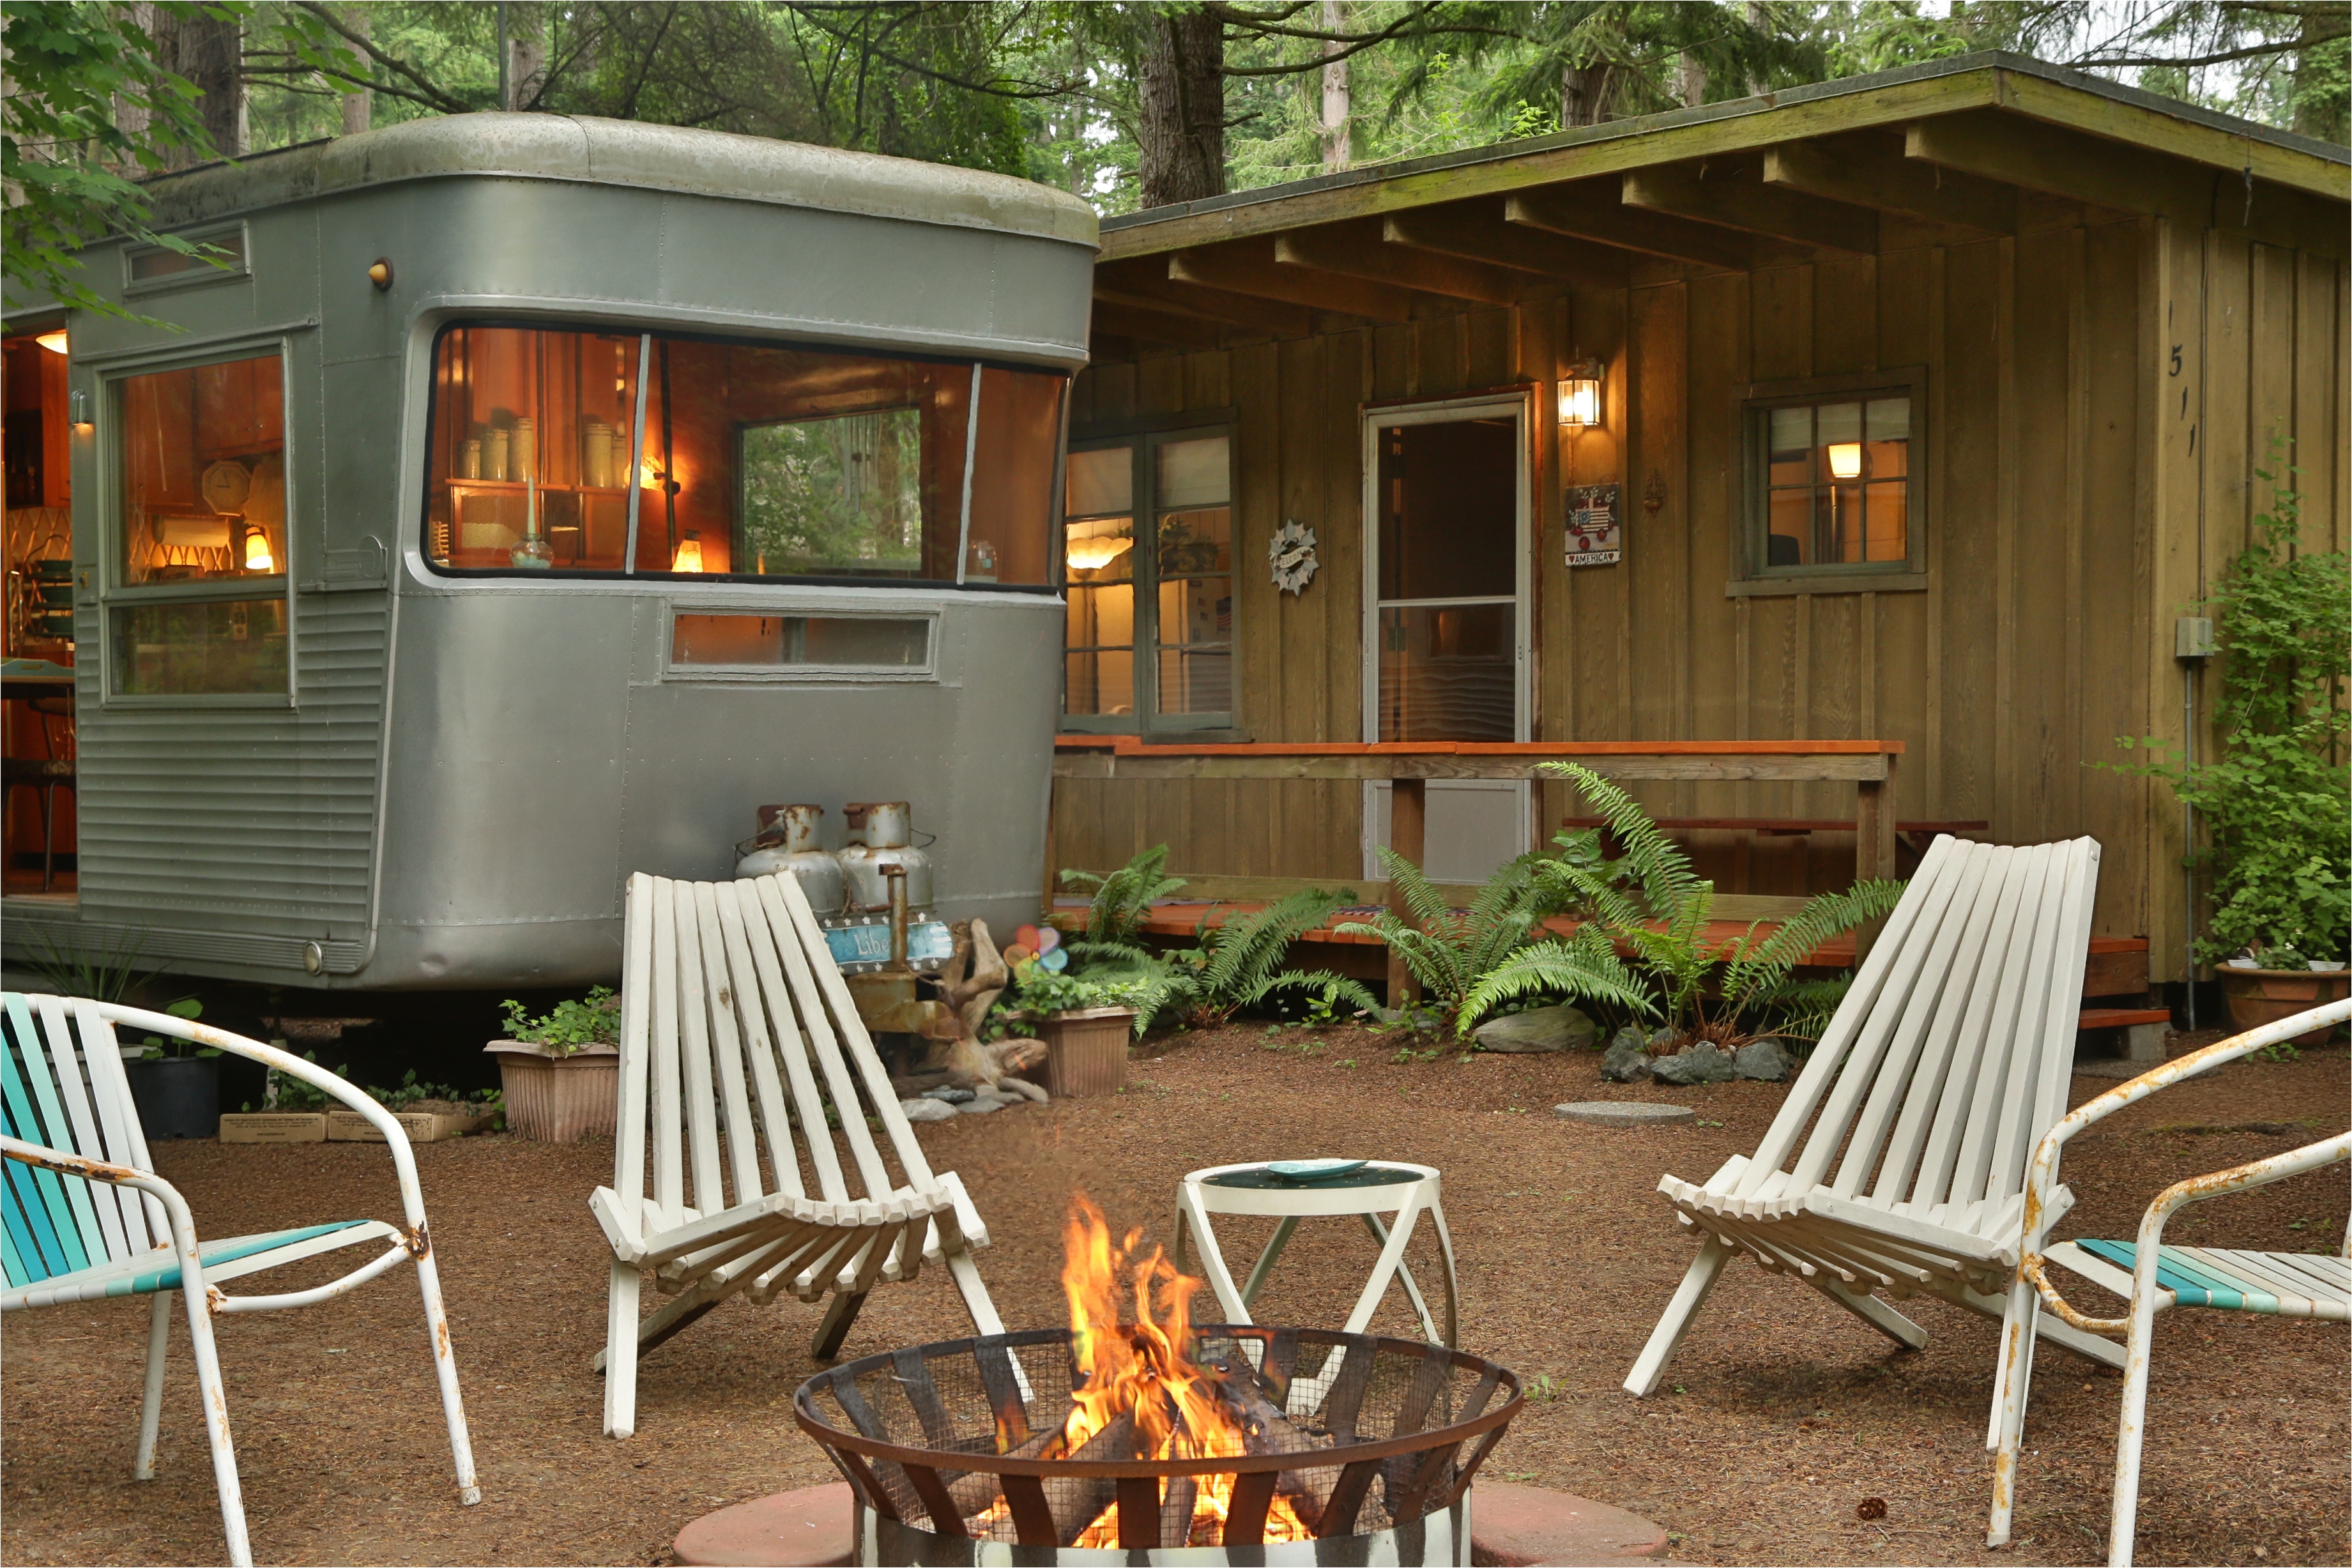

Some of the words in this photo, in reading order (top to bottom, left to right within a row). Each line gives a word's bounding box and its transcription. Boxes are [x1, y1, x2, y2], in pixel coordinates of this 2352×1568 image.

[2169, 343, 2196, 458] 511
[1277, 550, 1304, 565] ELCOM
[1575, 552, 1608, 563] AMERICA
[853, 930, 892, 956] Libe
